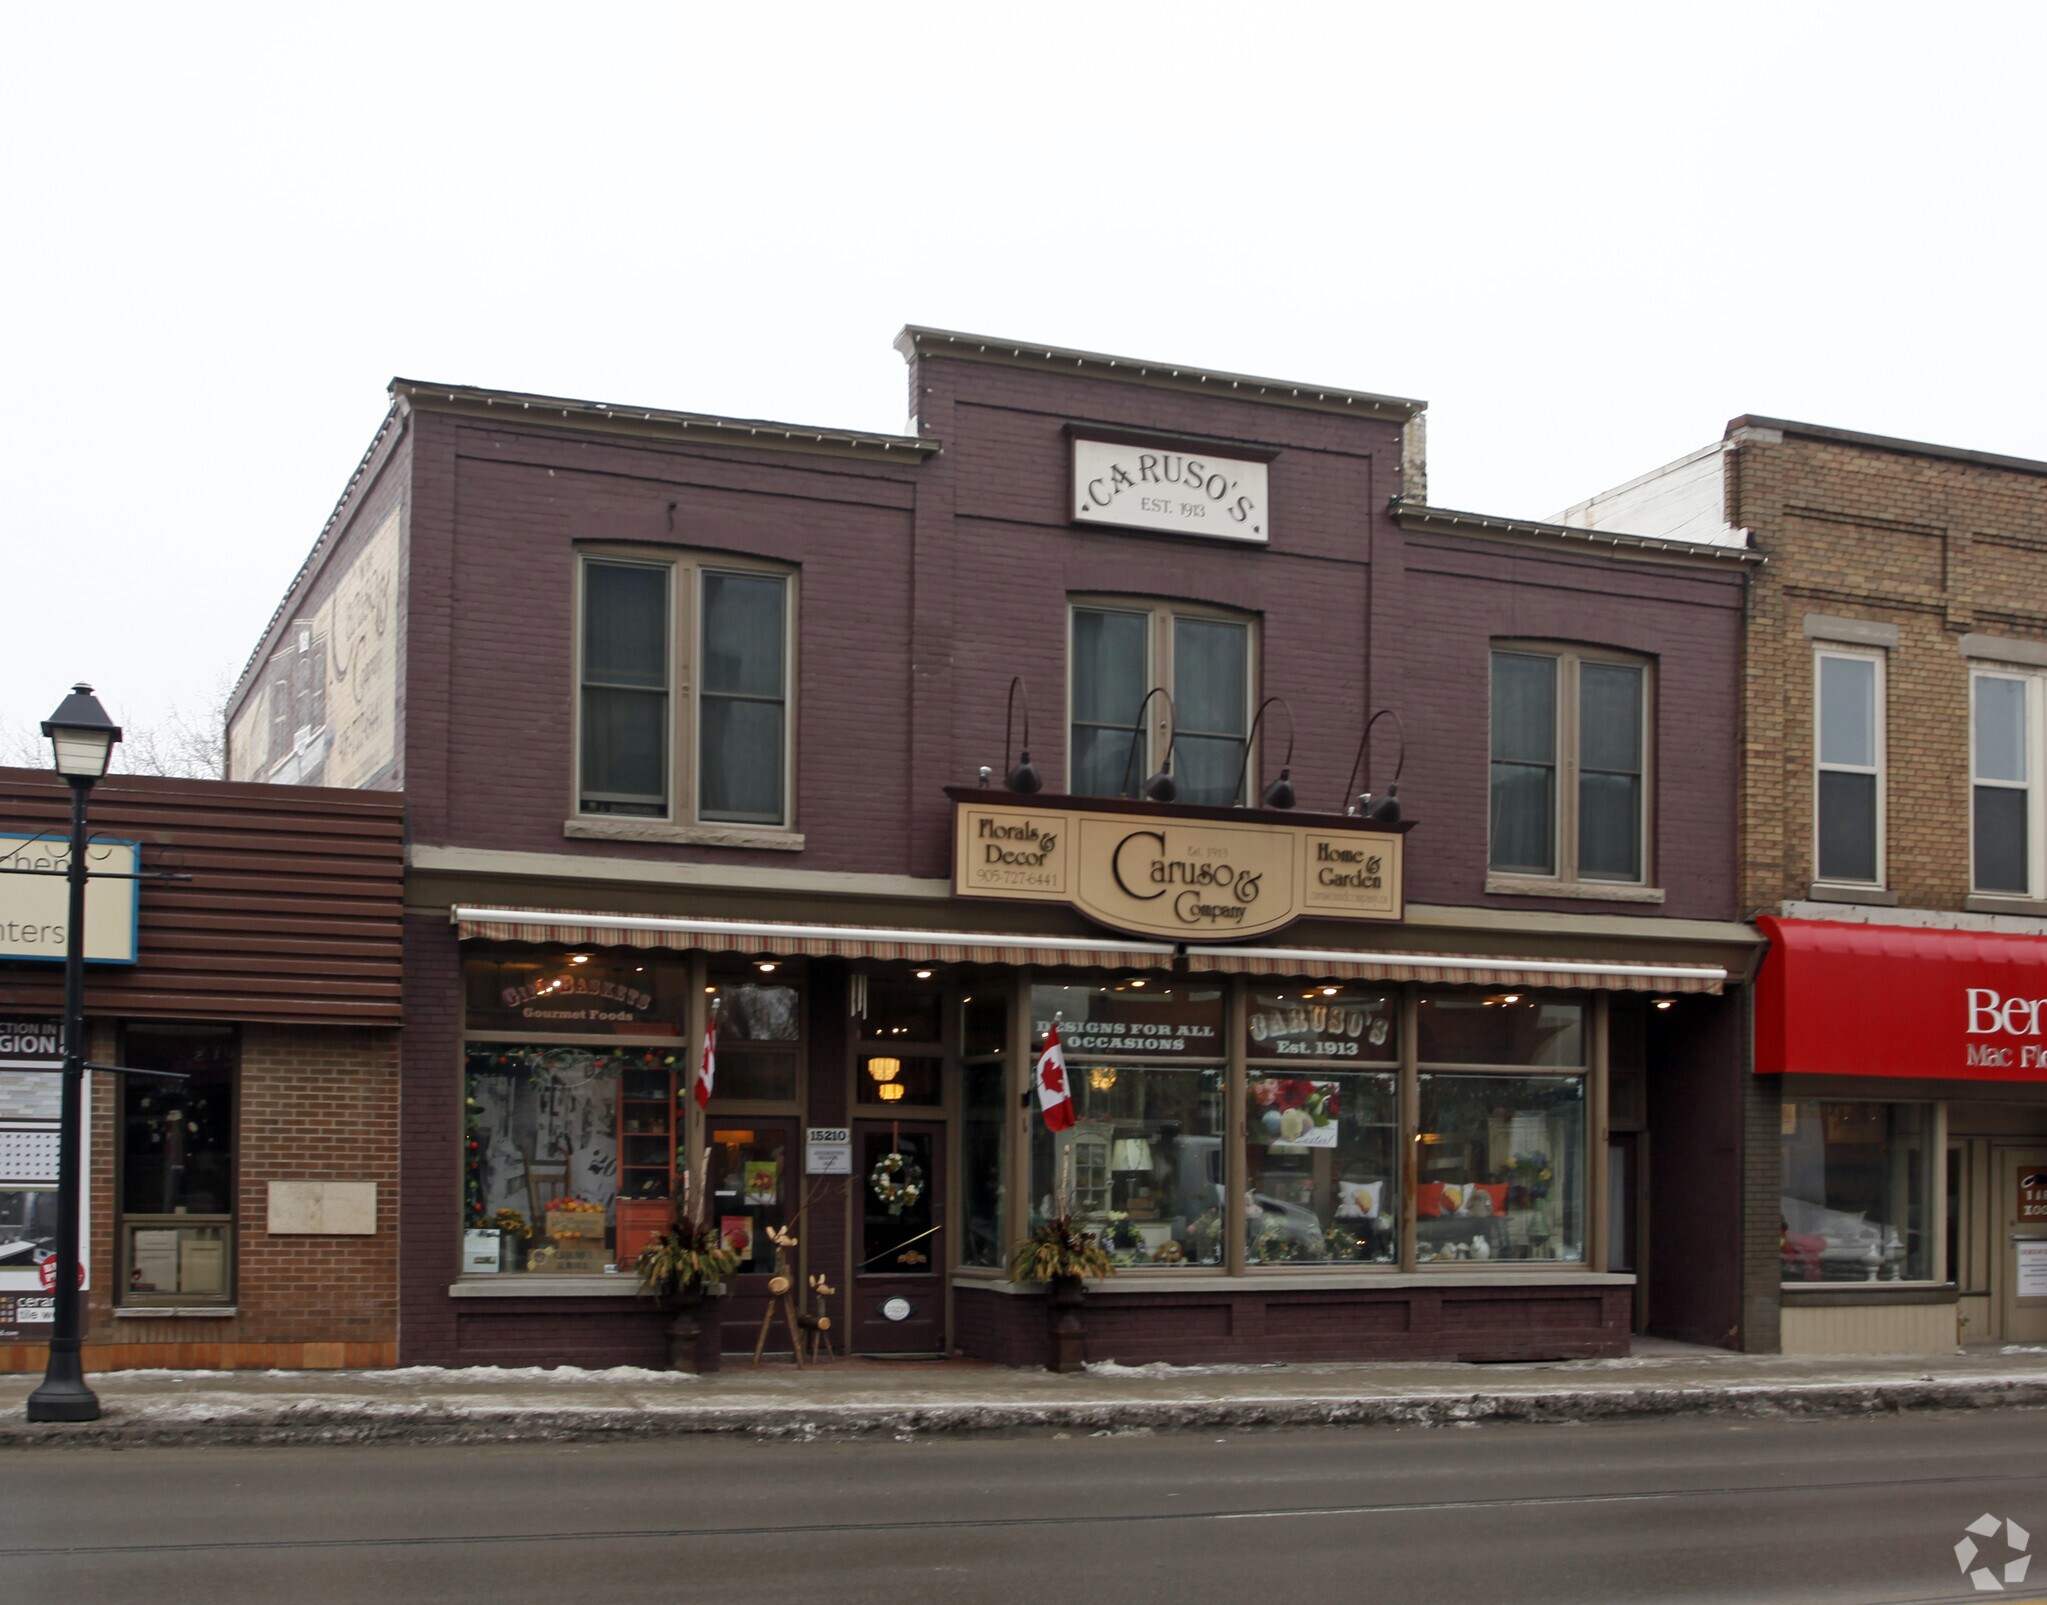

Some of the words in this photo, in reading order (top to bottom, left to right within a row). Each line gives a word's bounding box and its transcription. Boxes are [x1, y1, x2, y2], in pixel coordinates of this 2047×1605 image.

[1088, 453, 1255, 523] CARUSO'S
[1141, 497, 1174, 515] EST.
[1180, 502, 1206, 519] 1913
[978, 818, 1039, 842] Florals
[1039, 831, 1058, 853] &
[985, 843, 1047, 867] Decor
[1207, 847, 1229, 859] 1913
[1317, 842, 1365, 864] Home
[1366, 855, 1383, 874] &
[976, 868, 1058, 887] 905-727-6441
[1112, 830, 1234, 901] Caruso
[1234, 869, 1263, 903] &
[1318, 867, 1383, 889] Garden
[1174, 889, 1247, 925] Company
[523, 1007, 587, 1020] Gourmet
[589, 1009, 634, 1022] Foods
[1249, 1005, 1390, 1046] CARUSO'S
[1129, 1024, 1172, 1036] FOR
[1175, 1025, 1215, 1037] ALL
[1067, 1036, 1185, 1051] OCCASIONS
[1315, 1041, 1360, 1056] 1913
[1966, 1043, 2013, 1068] Mac
[810, 1130, 847, 1141] 15210
[16, 1297, 56, 1308] cera
